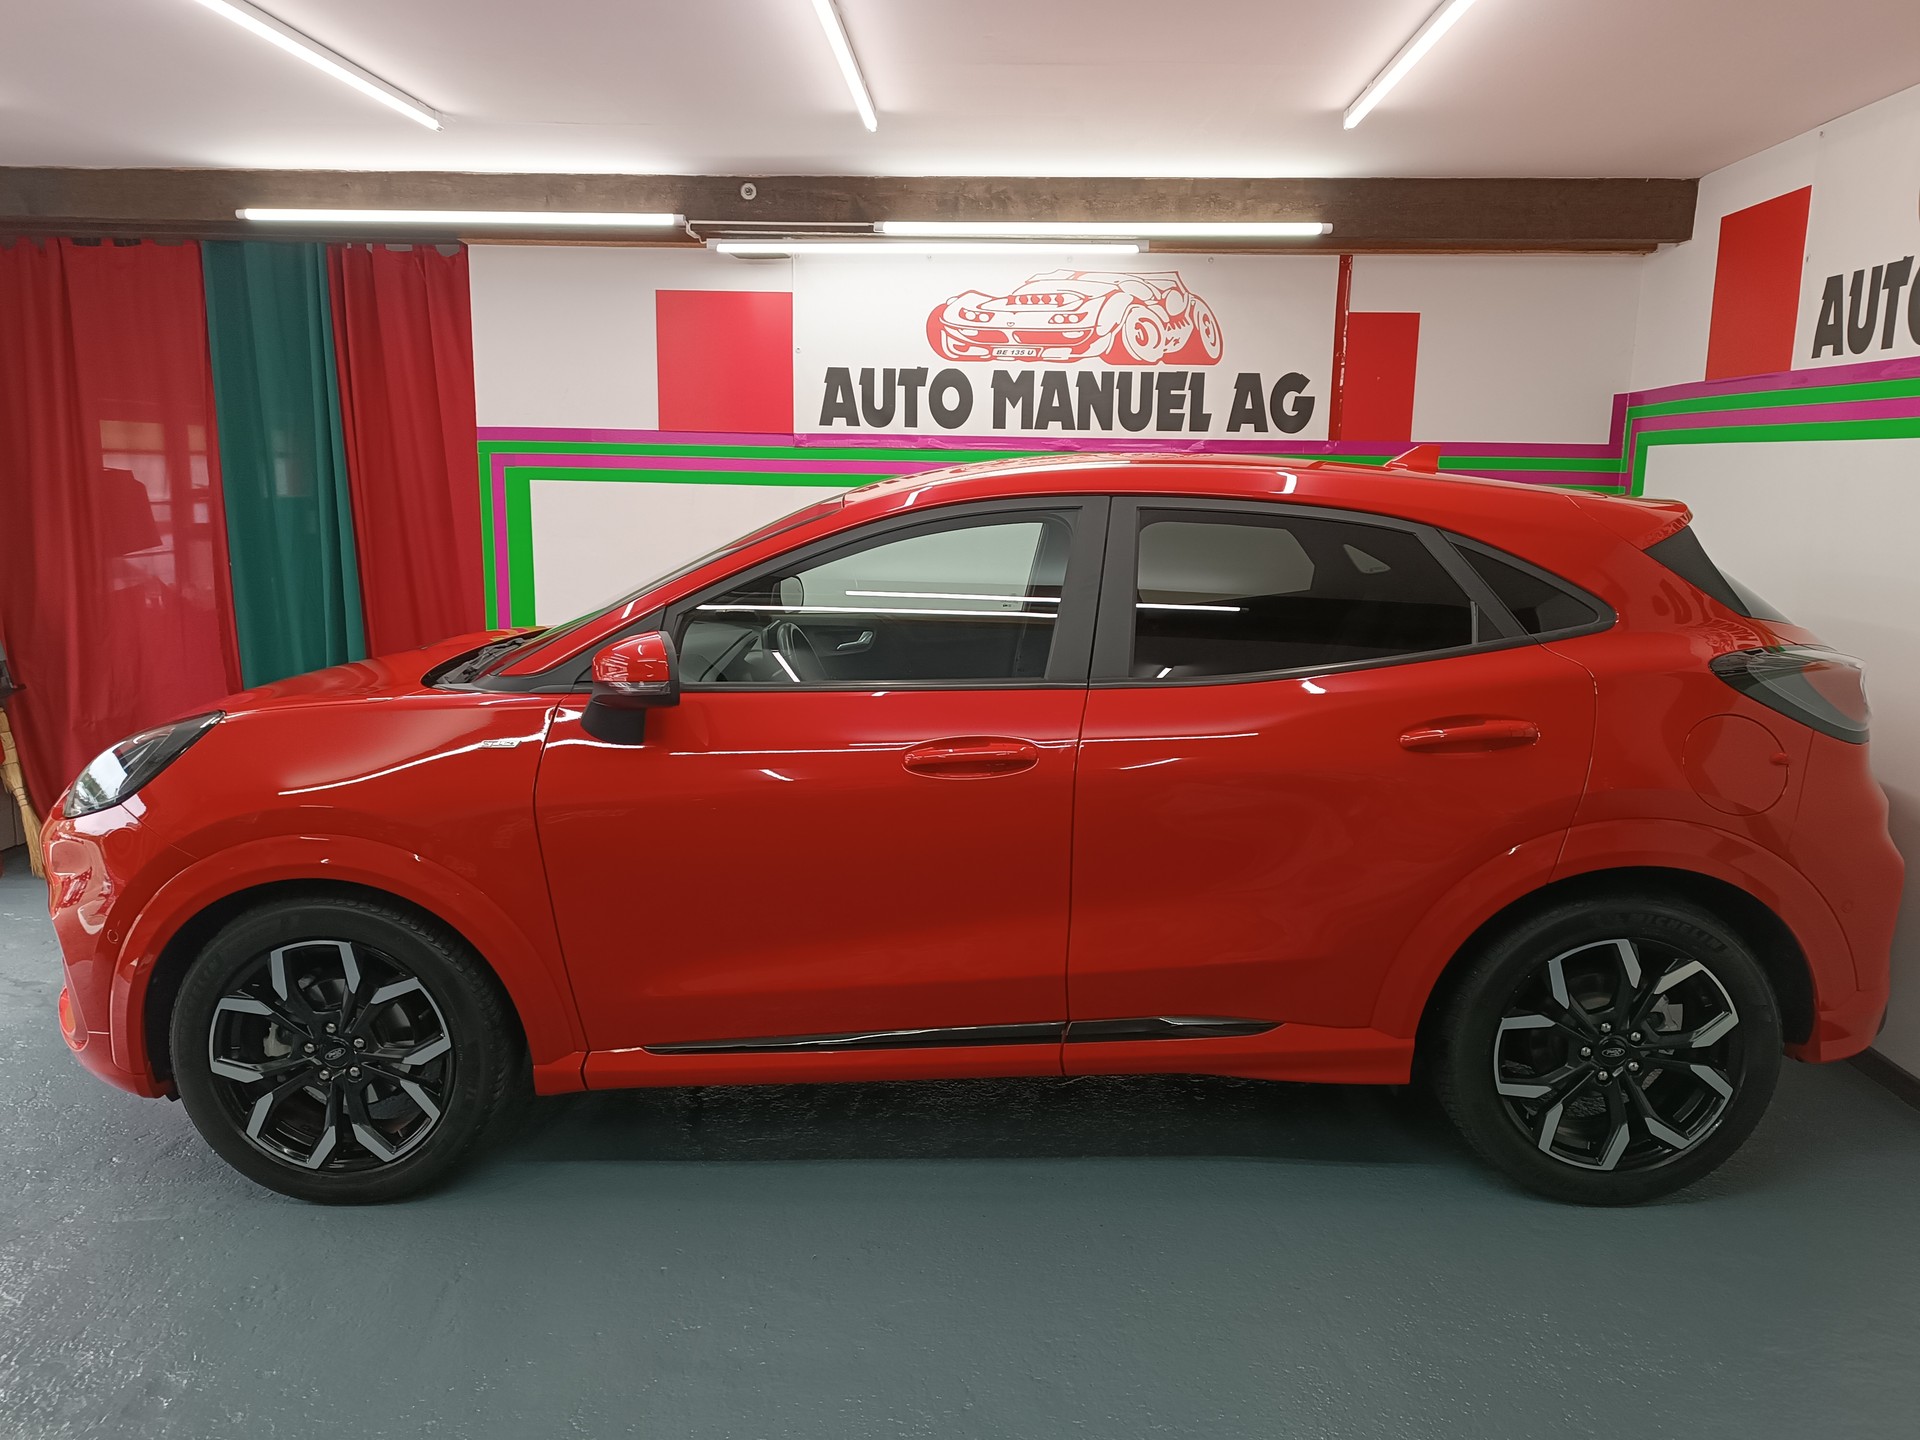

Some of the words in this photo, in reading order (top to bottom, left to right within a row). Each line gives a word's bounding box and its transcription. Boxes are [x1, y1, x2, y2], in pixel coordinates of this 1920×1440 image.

[818, 366, 974, 429] AUTO
[990, 370, 1212, 432] MANUEL
[1226, 372, 1316, 434] AG
